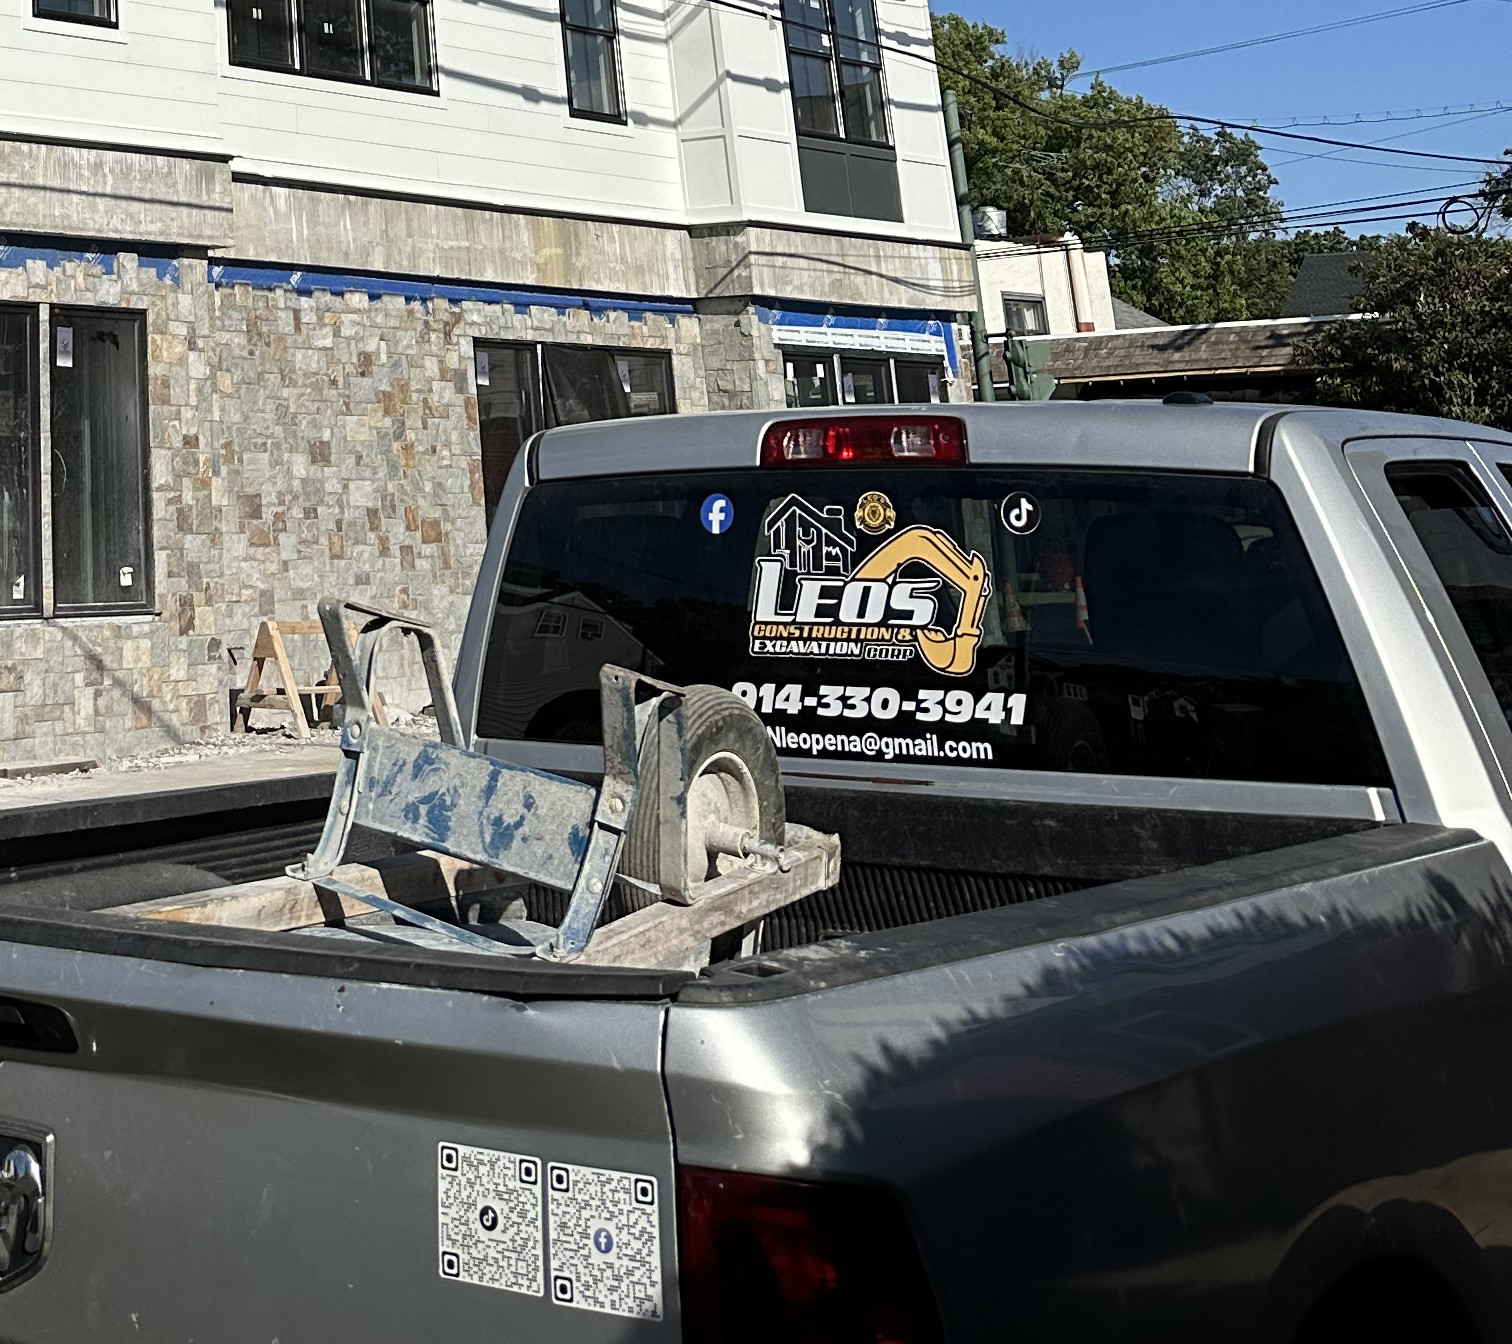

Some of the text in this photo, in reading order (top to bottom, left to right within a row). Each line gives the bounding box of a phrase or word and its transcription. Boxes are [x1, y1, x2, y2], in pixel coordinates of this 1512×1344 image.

[755, 559, 941, 626] LEOS
[753, 624, 911, 640] CONSTRUCTION &
[753, 640, 861, 656] EXCAVATION
[864, 645, 915, 661] CORP
[731, 681, 1027, 726] 914-330-3941
